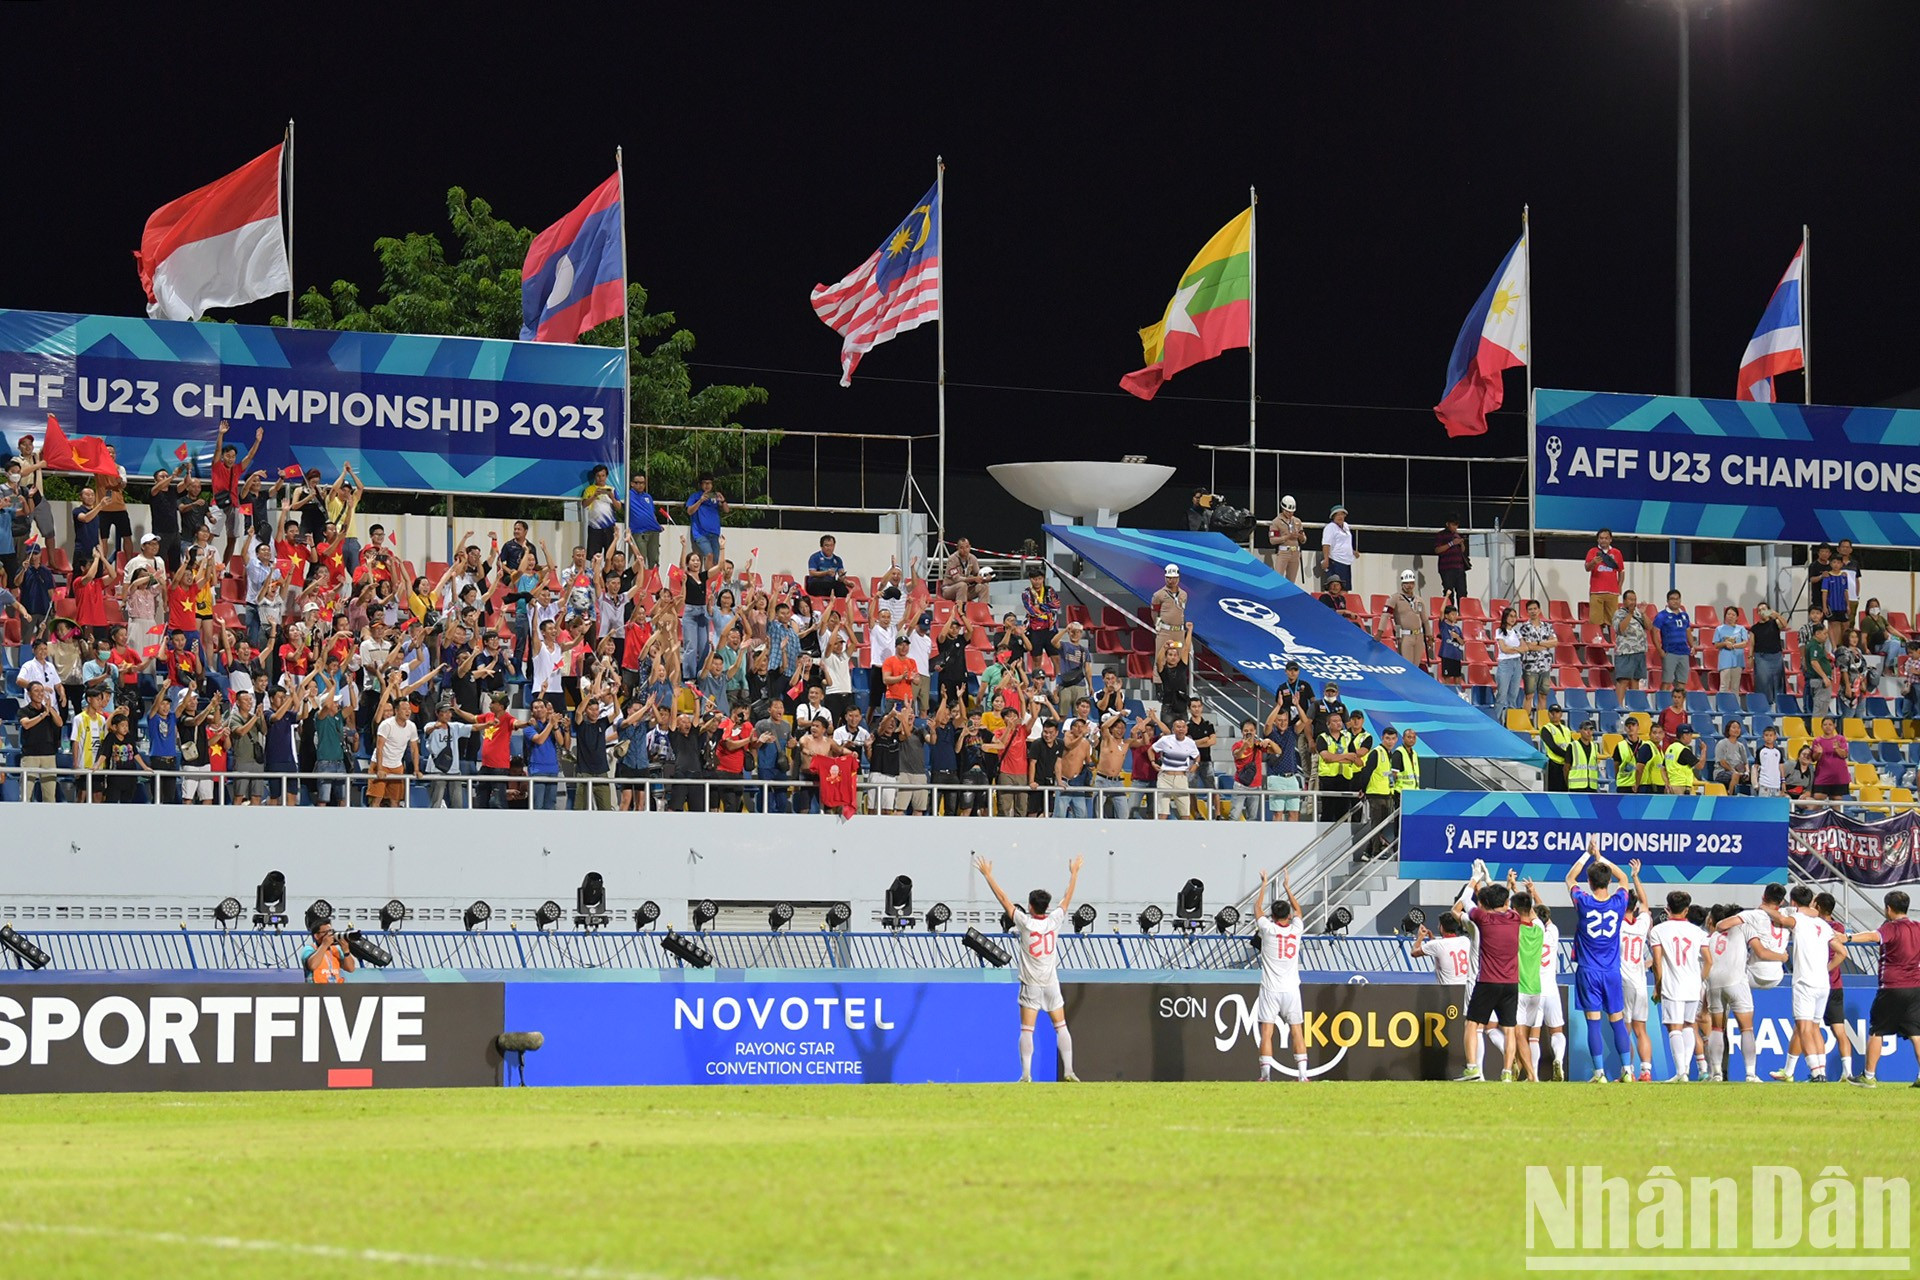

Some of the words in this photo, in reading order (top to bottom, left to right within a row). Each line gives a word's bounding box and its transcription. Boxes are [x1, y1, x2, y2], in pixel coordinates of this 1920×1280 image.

[0, 373, 64, 408] FF
[79, 377, 159, 415] U23
[172, 382, 499, 433] CHAMPIONSHIP
[509, 402, 604, 440] 2023
[1568, 447, 1638, 479] AFF
[1648, 451, 1711, 483] U23
[1720, 454, 1920, 494] CHAMPIONS
[1268, 653, 1310, 664] AFF
[1312, 655, 1360, 664] U23
[1307, 670, 1364, 681] 2023
[1458, 830, 1497, 850] AFF
[1502, 831, 1539, 850] U23
[1696, 834, 1743, 853] 2023
[1586, 909, 1619, 939] 23
[1029, 930, 1055, 958] 20
[1278, 933, 1297, 960] 16
[1622, 936, 1641, 964] 10
[1673, 936, 1692, 966] 17
[1449, 950, 1469, 976] 18
[674, 996, 895, 1031] NOVOTEL
[1159, 996, 1207, 1018] SƠN
[0, 996, 427, 1066] SPORTFIVE
[735, 1042, 796, 1056] RAYONG
[799, 1042, 835, 1056] STAR
[706, 1061, 801, 1076] CONVENTION
[806, 1061, 862, 1075] CENTRE
